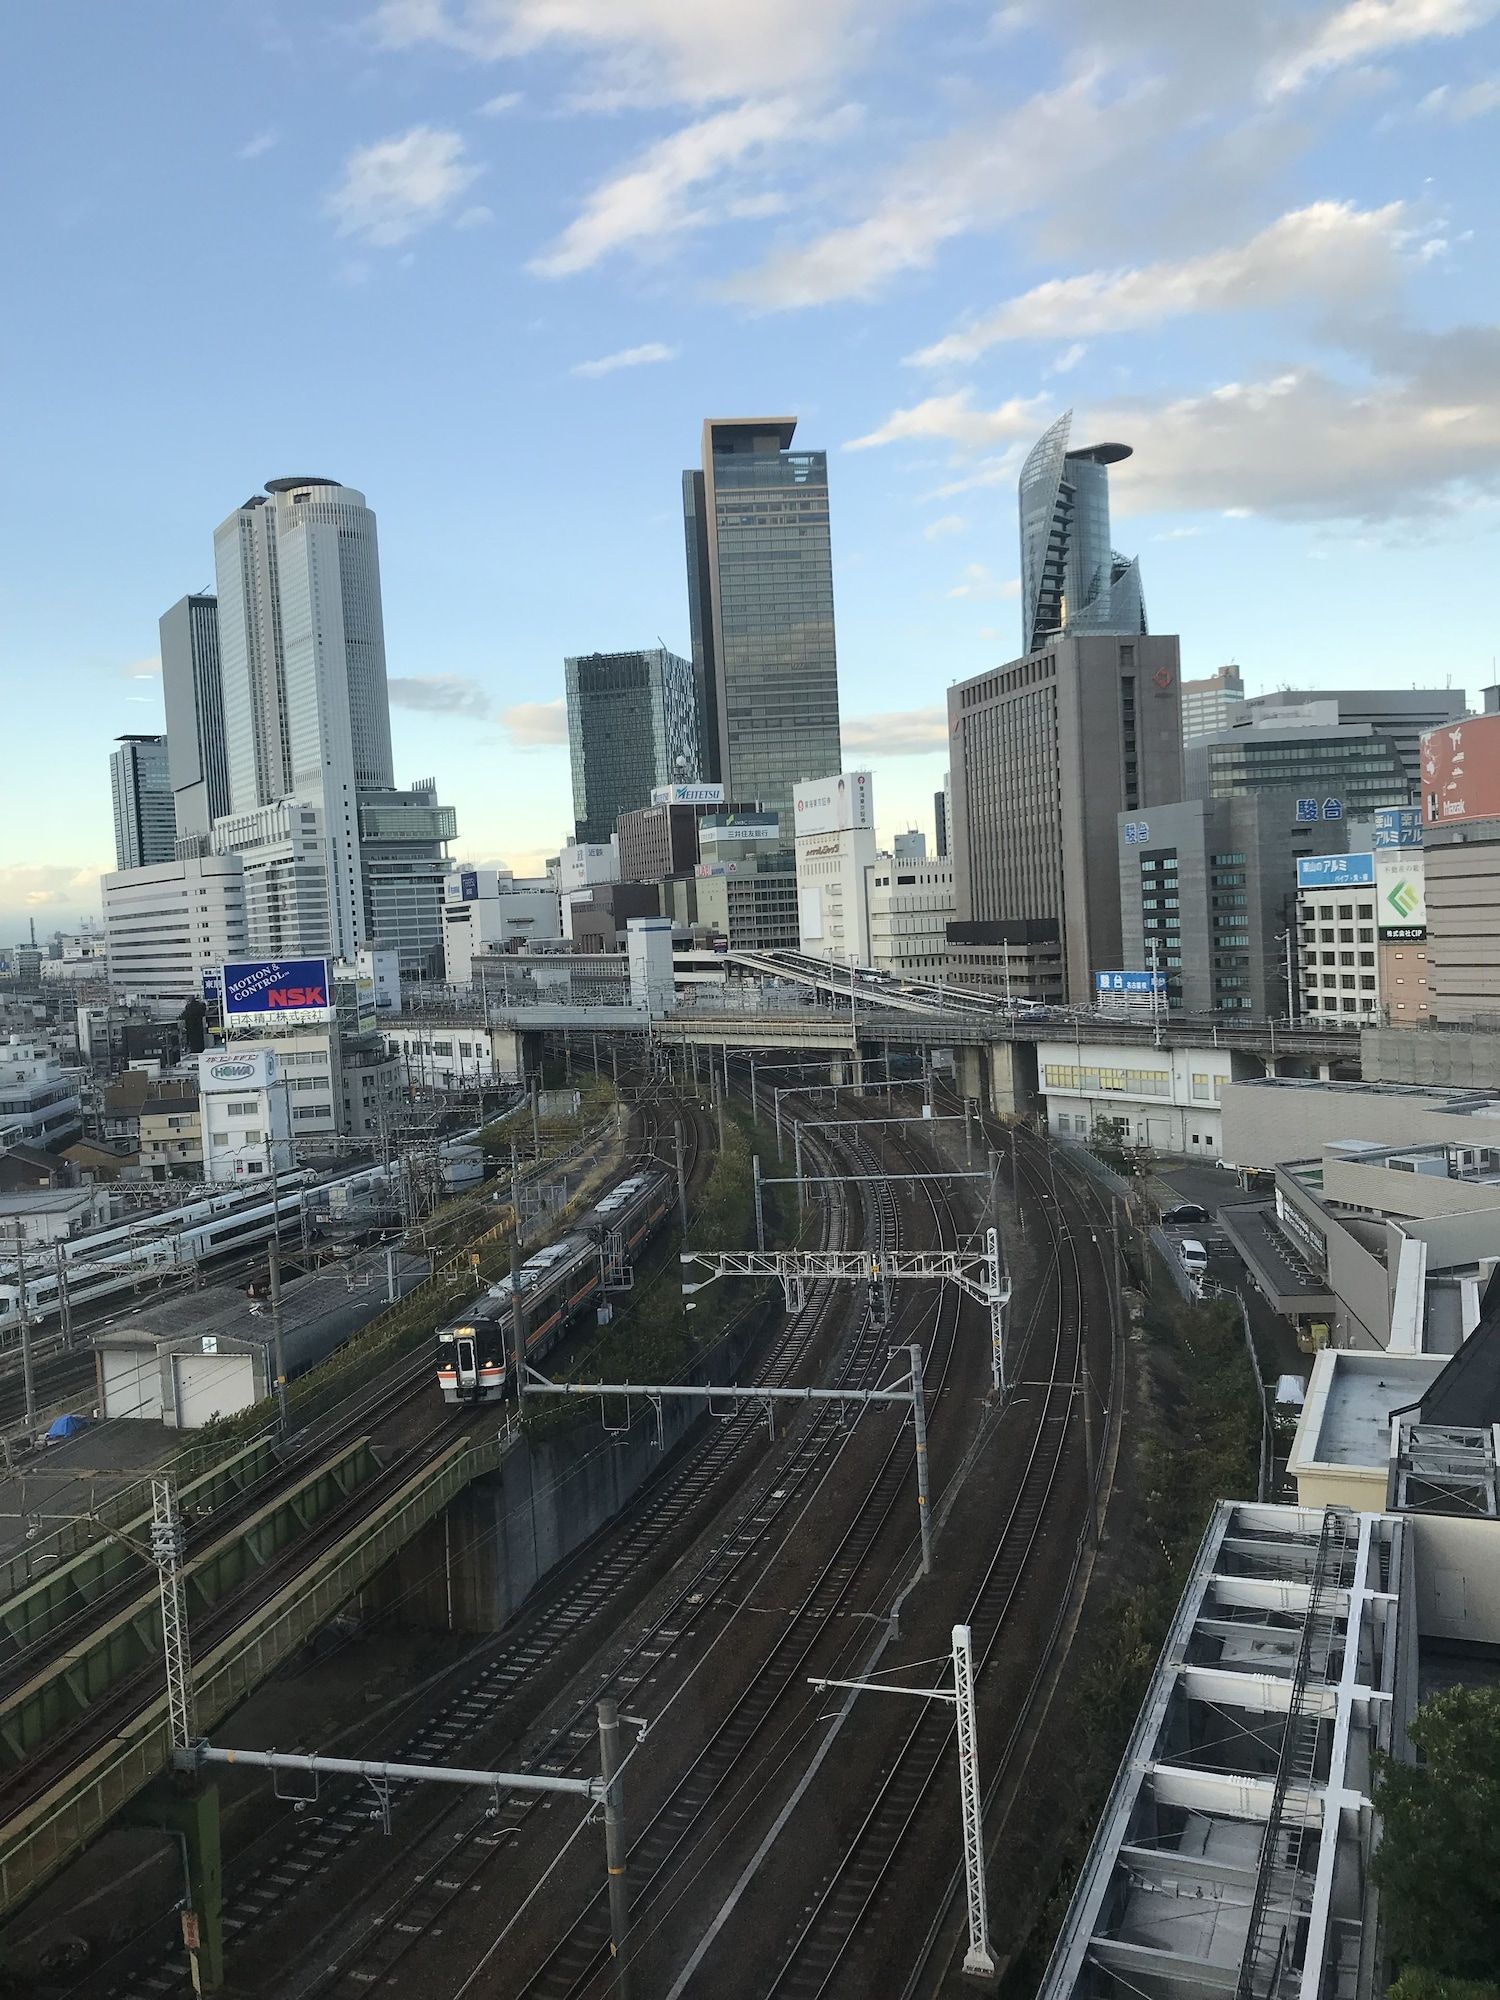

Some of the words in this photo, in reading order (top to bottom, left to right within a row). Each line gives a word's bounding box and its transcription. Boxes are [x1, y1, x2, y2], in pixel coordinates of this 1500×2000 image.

[675, 785, 720, 799] MEITETSU
[1296, 797, 1343, 822] 駿台
[1124, 821, 1150, 845] 駿台
[227, 967, 272, 994] MOTION
[271, 962, 281, 972] &
[267, 986, 326, 1008] NSK
[229, 1009, 325, 1025] 日本精工株式会社
[214, 1065, 251, 1077] HOWA
